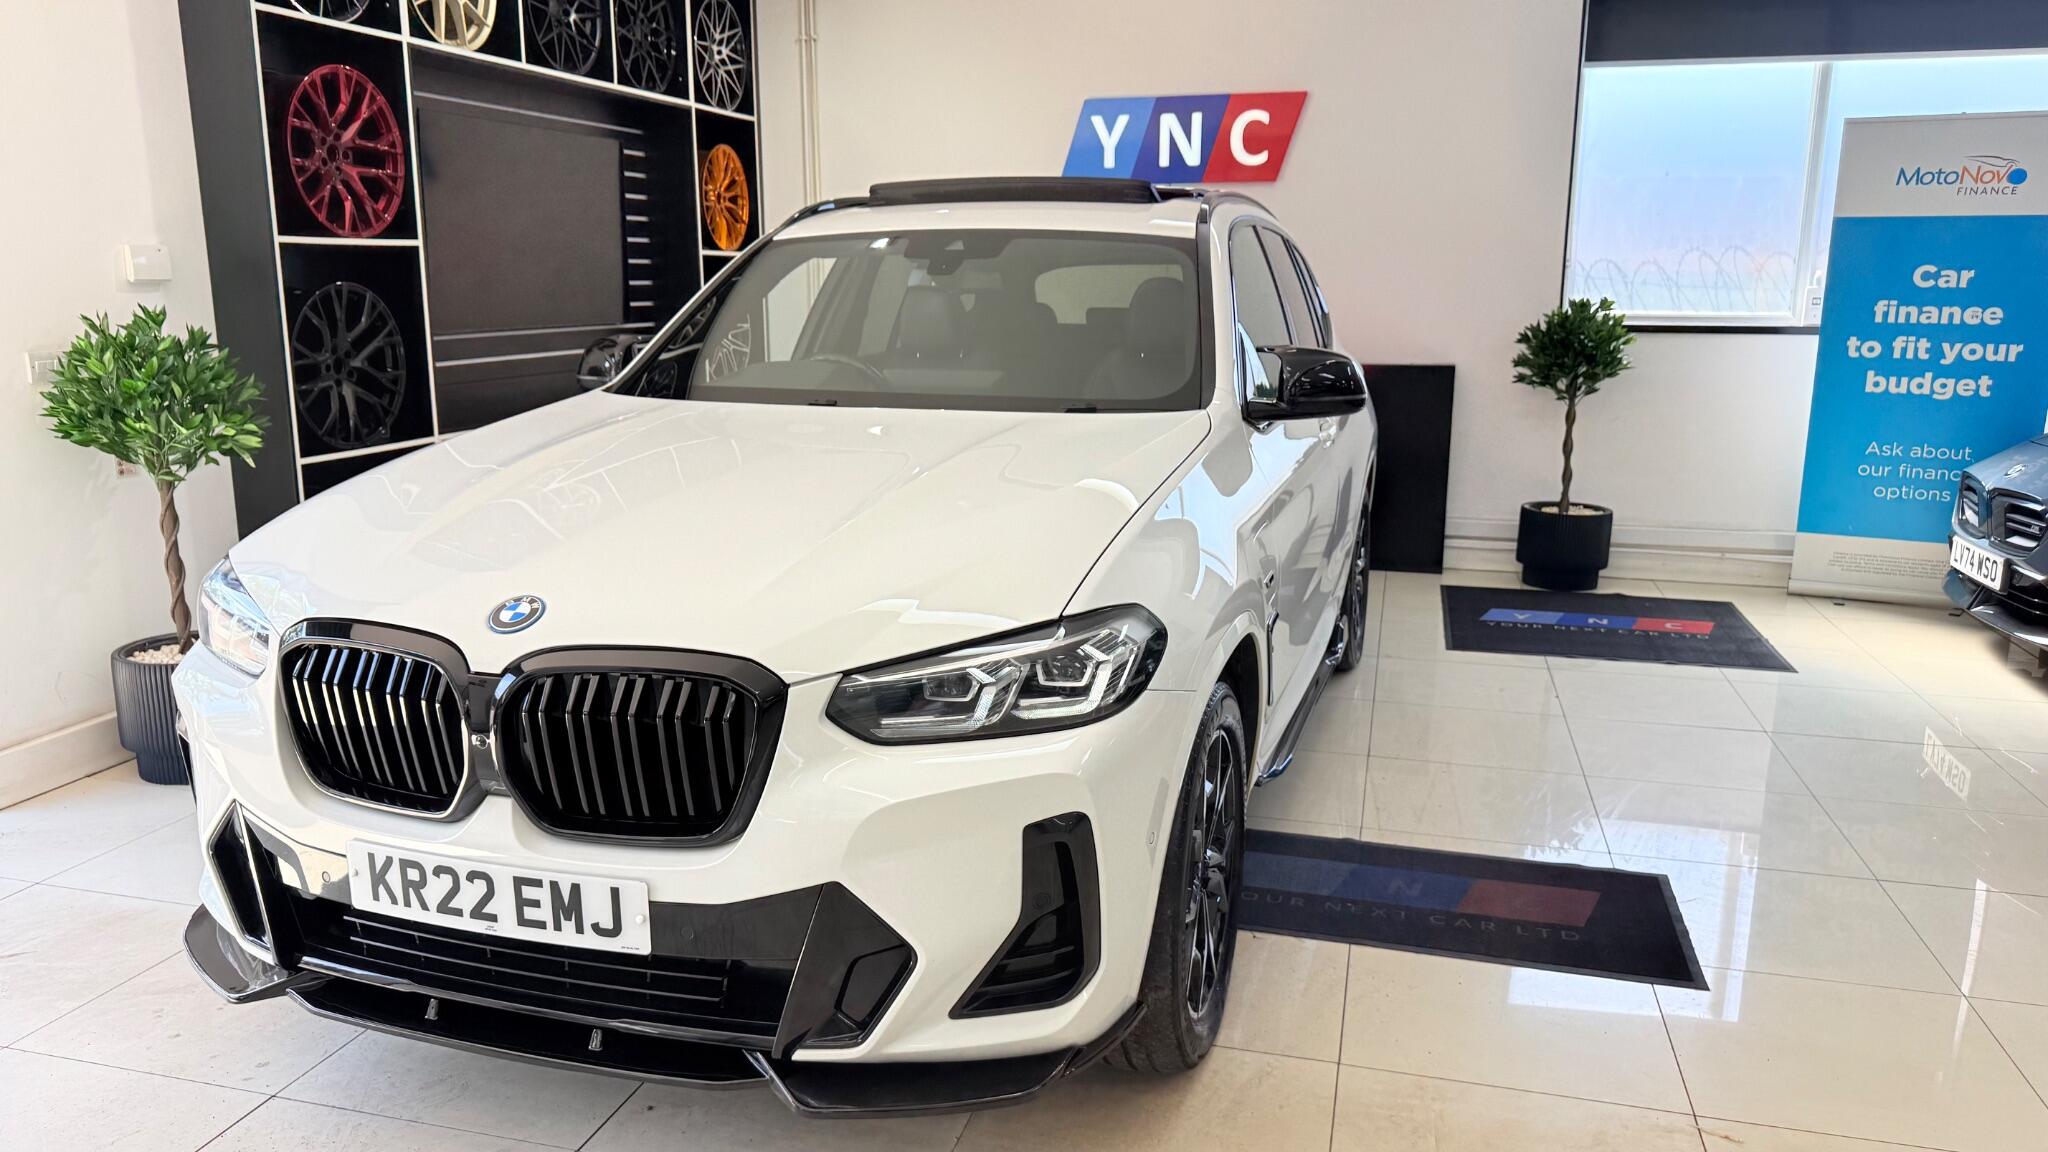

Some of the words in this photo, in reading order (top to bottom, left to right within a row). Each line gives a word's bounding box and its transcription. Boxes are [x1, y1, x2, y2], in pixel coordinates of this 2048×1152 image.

[1090, 108, 1271, 169] YNC
[1956, 186, 2018, 196] FINANCE
[1913, 264, 1975, 288] Car
[1874, 300, 2004, 325] finance
[1846, 336, 1882, 358] to
[1892, 336, 1931, 360] fit
[1940, 342, 2024, 365] your
[1865, 370, 1993, 400] budget
[1865, 441, 1903, 457] Ask
[1910, 443, 1973, 460] about
[1857, 464, 1892, 477] our
[1899, 463, 1961, 481] financ
[1873, 485, 1951, 502] options
[1953, 541, 1976, 573] LV74
[1487, 621, 1543, 630] YOUR
[1553, 625, 1608, 634] NEXT
[1617, 629, 1660, 637] CAR
[1670, 632, 1710, 640] LTD
[367, 851, 498, 923] KR22
[512, 875, 623, 938] EMJ
[1241, 891, 1304, 907] OUR
[1324, 902, 1408, 919] NEXT
[1429, 915, 1497, 932] CAR
[1515, 925, 1580, 941] LTD
